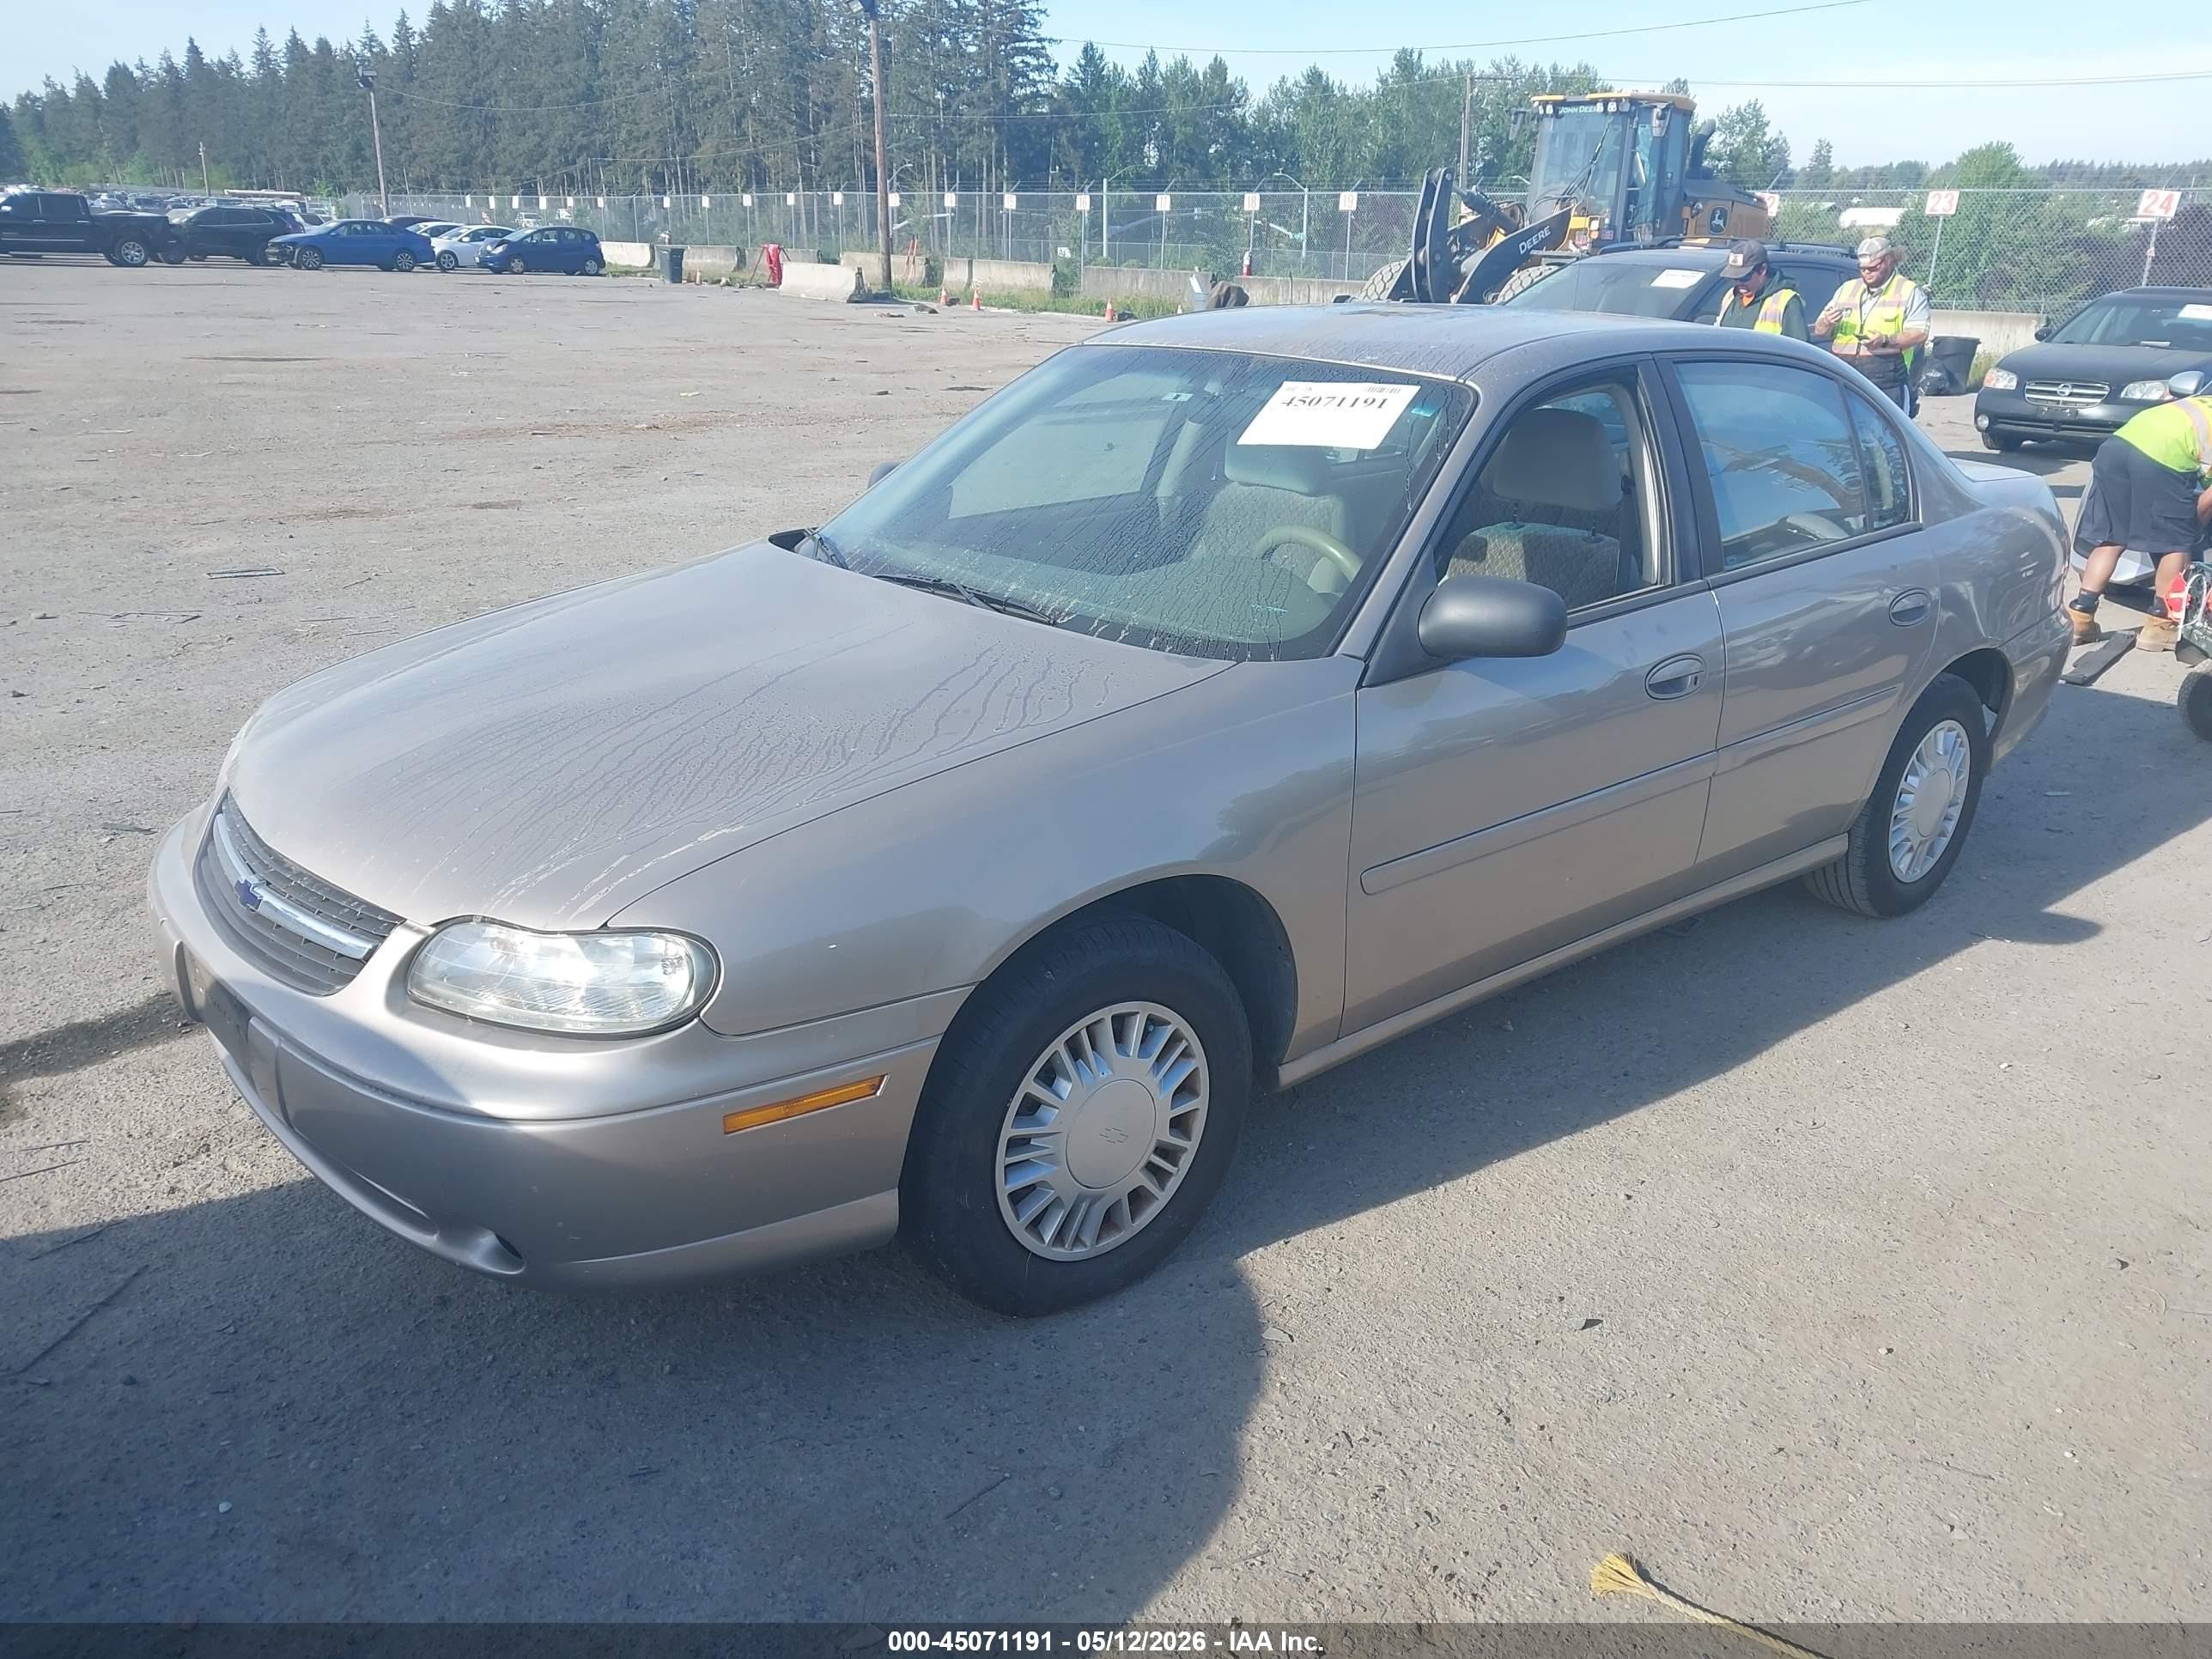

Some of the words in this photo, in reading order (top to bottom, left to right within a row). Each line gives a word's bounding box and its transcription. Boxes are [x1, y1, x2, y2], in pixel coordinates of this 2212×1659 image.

[1559, 106, 1578, 114] JOHN
[1079, 195, 1088, 208] 16
[1160, 195, 1168, 209] 17
[1248, 195, 1257, 210] 18
[1343, 193, 1354, 209] 19
[1929, 192, 1955, 213] 23
[2142, 191, 2174, 215] 24
[1518, 225, 1552, 255] DEERE
[1281, 395, 1389, 410] 45071191
